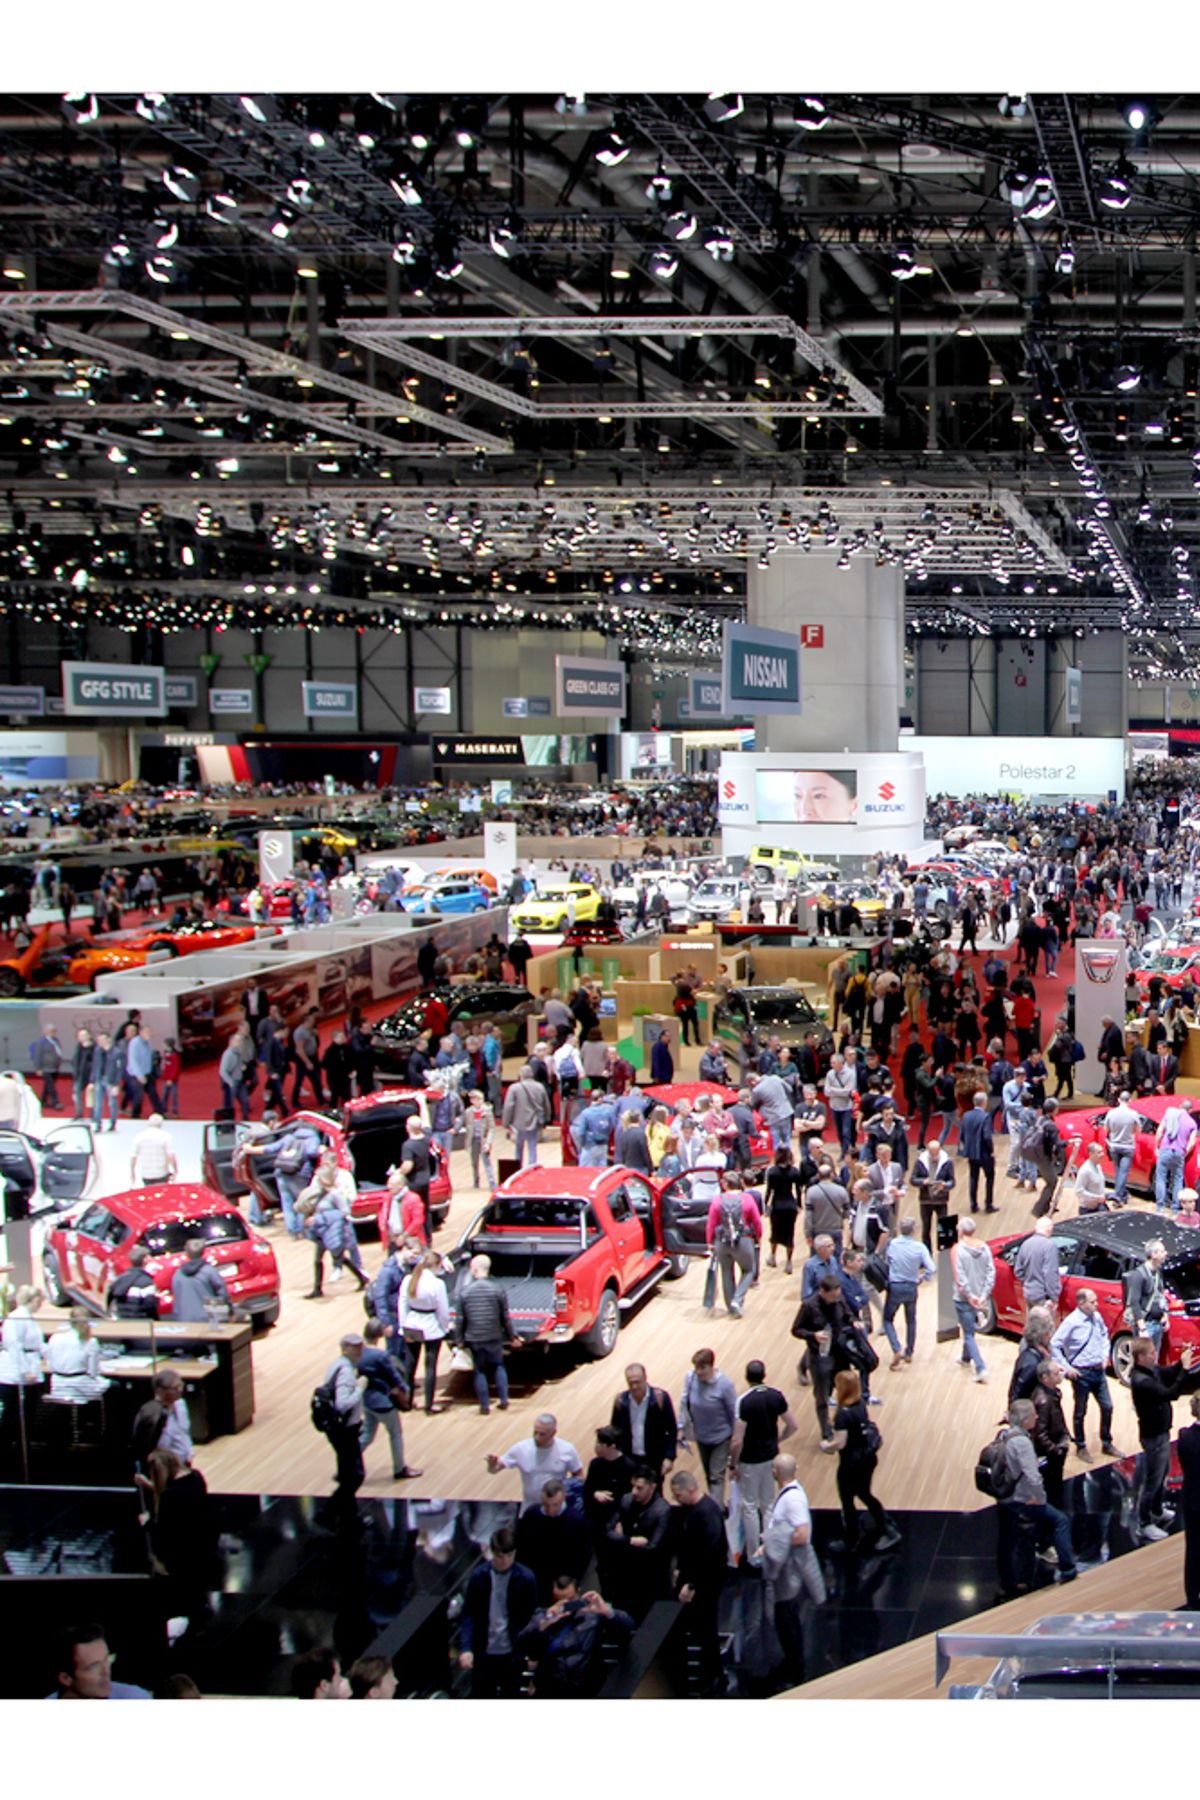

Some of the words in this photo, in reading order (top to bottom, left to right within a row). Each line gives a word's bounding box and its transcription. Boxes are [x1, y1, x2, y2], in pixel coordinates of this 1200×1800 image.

[806, 626, 819, 643] F
[743, 653, 789, 689] NISSAN
[80, 680, 110, 698] GFG
[112, 681, 152, 699] STYLE
[455, 744, 518, 755] MASERATI
[1000, 763, 1063, 779] Polestar
[1066, 765, 1076, 780] 2
[864, 803, 905, 812] SUZUKI
